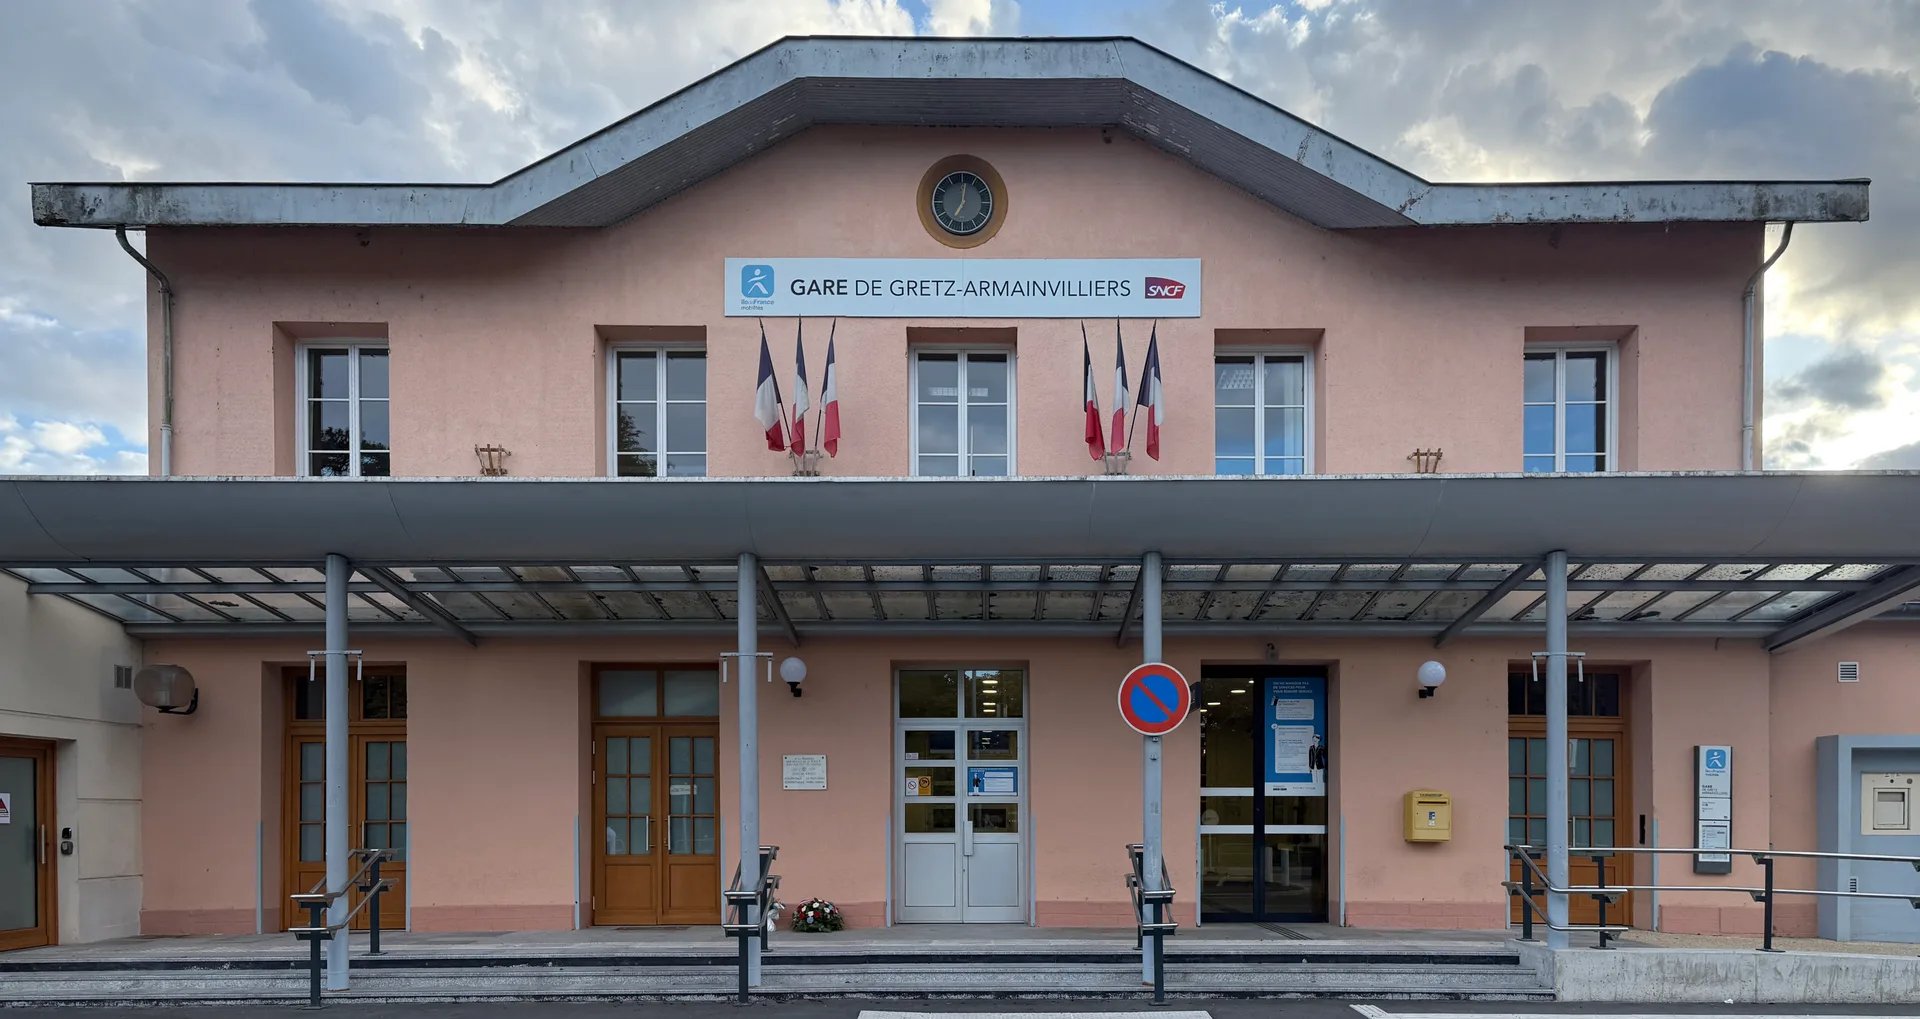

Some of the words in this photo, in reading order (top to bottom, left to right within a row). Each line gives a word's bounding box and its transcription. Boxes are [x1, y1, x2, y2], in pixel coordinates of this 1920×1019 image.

[790, 279, 848, 296] GARE
[855, 280, 882, 296] DE
[889, 279, 1131, 297] GRETZ-ARMAINVILLIERS
[1147, 285, 1184, 296] SNCF
